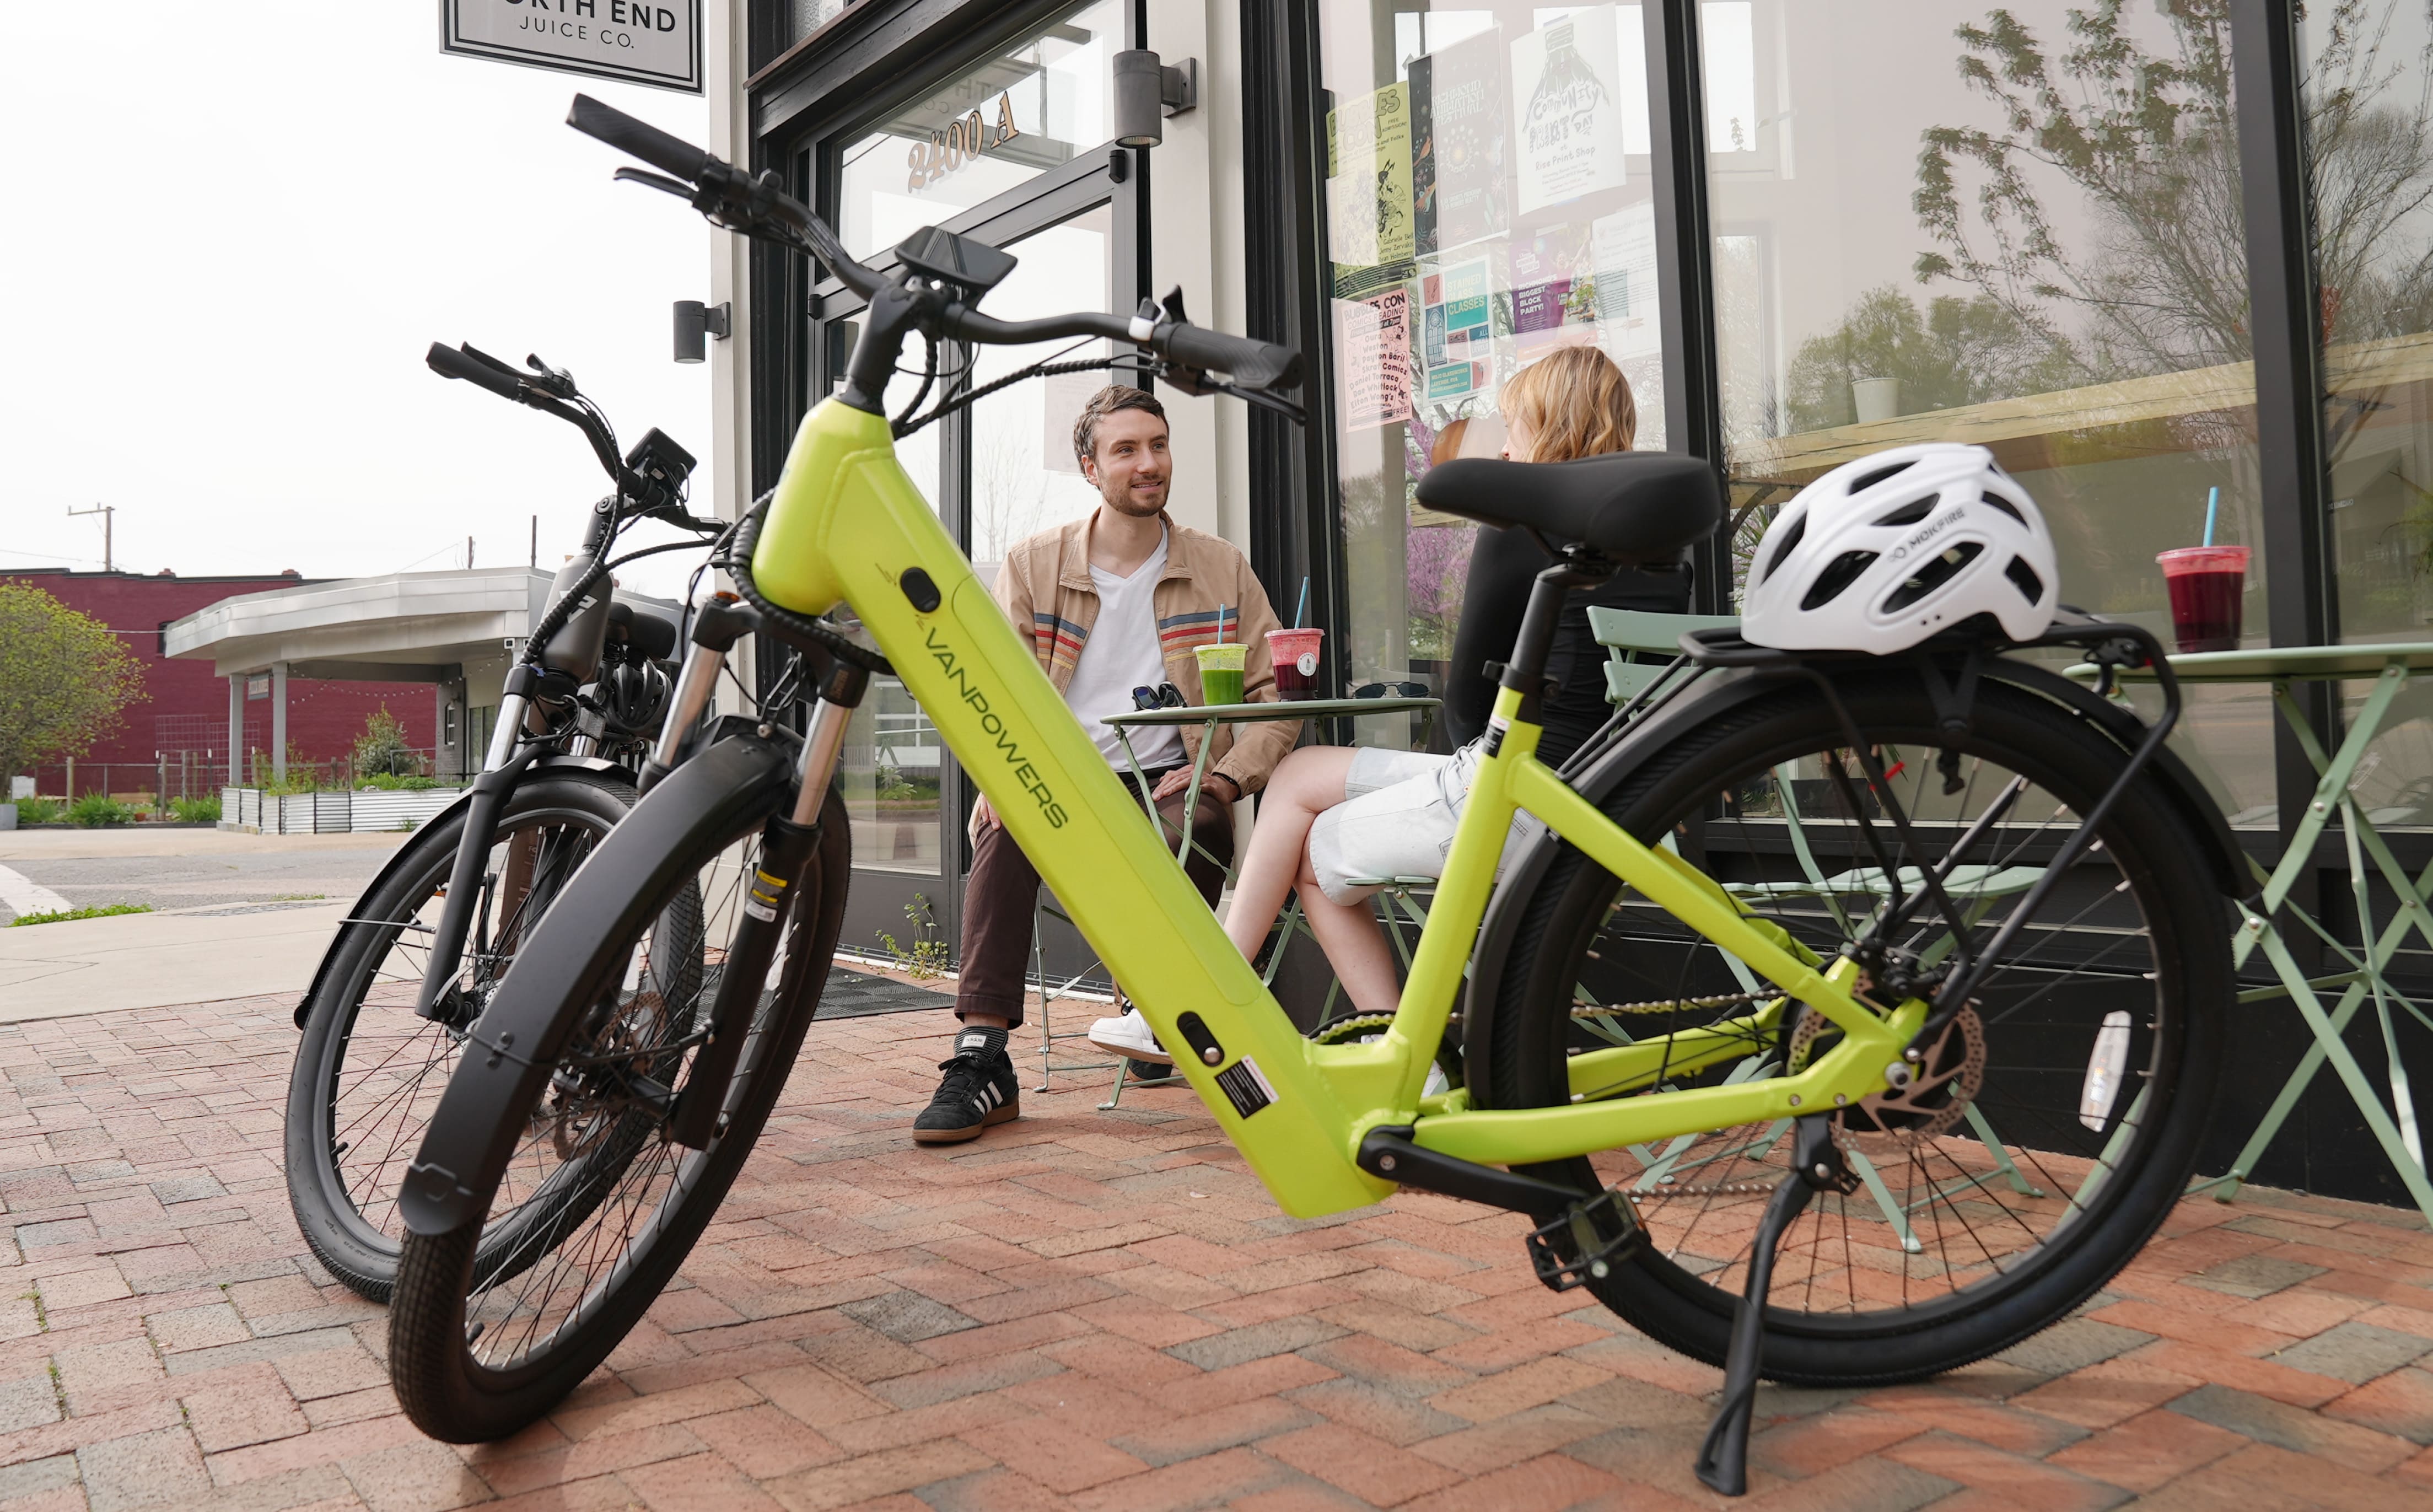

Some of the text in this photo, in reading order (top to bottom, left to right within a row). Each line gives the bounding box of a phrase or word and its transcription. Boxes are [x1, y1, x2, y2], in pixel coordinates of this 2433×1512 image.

[611, 0, 676, 32] END
[519, 16, 634, 49] JUICE CO.
[908, 90, 1020, 193] 2400 A
[1552, 150, 1575, 166] Print
[1575, 146, 1596, 158] Shop
[1447, 273, 1482, 292] STAINED
[1384, 292, 1406, 309] CON
[1447, 287, 1474, 303] GLASS
[1519, 286, 1546, 299] BIGGEST
[1449, 296, 1485, 316] CLASSES
[1520, 296, 1542, 308] BLOCK
[1520, 303, 1544, 316] PARTY!
[1374, 305, 1404, 320] READING
[1382, 362, 1408, 375] Comics
[1393, 406, 1409, 415] FREE!
[1908, 507, 1967, 551] MOKFIRE
[925, 627, 1069, 829] VANPOWERS
